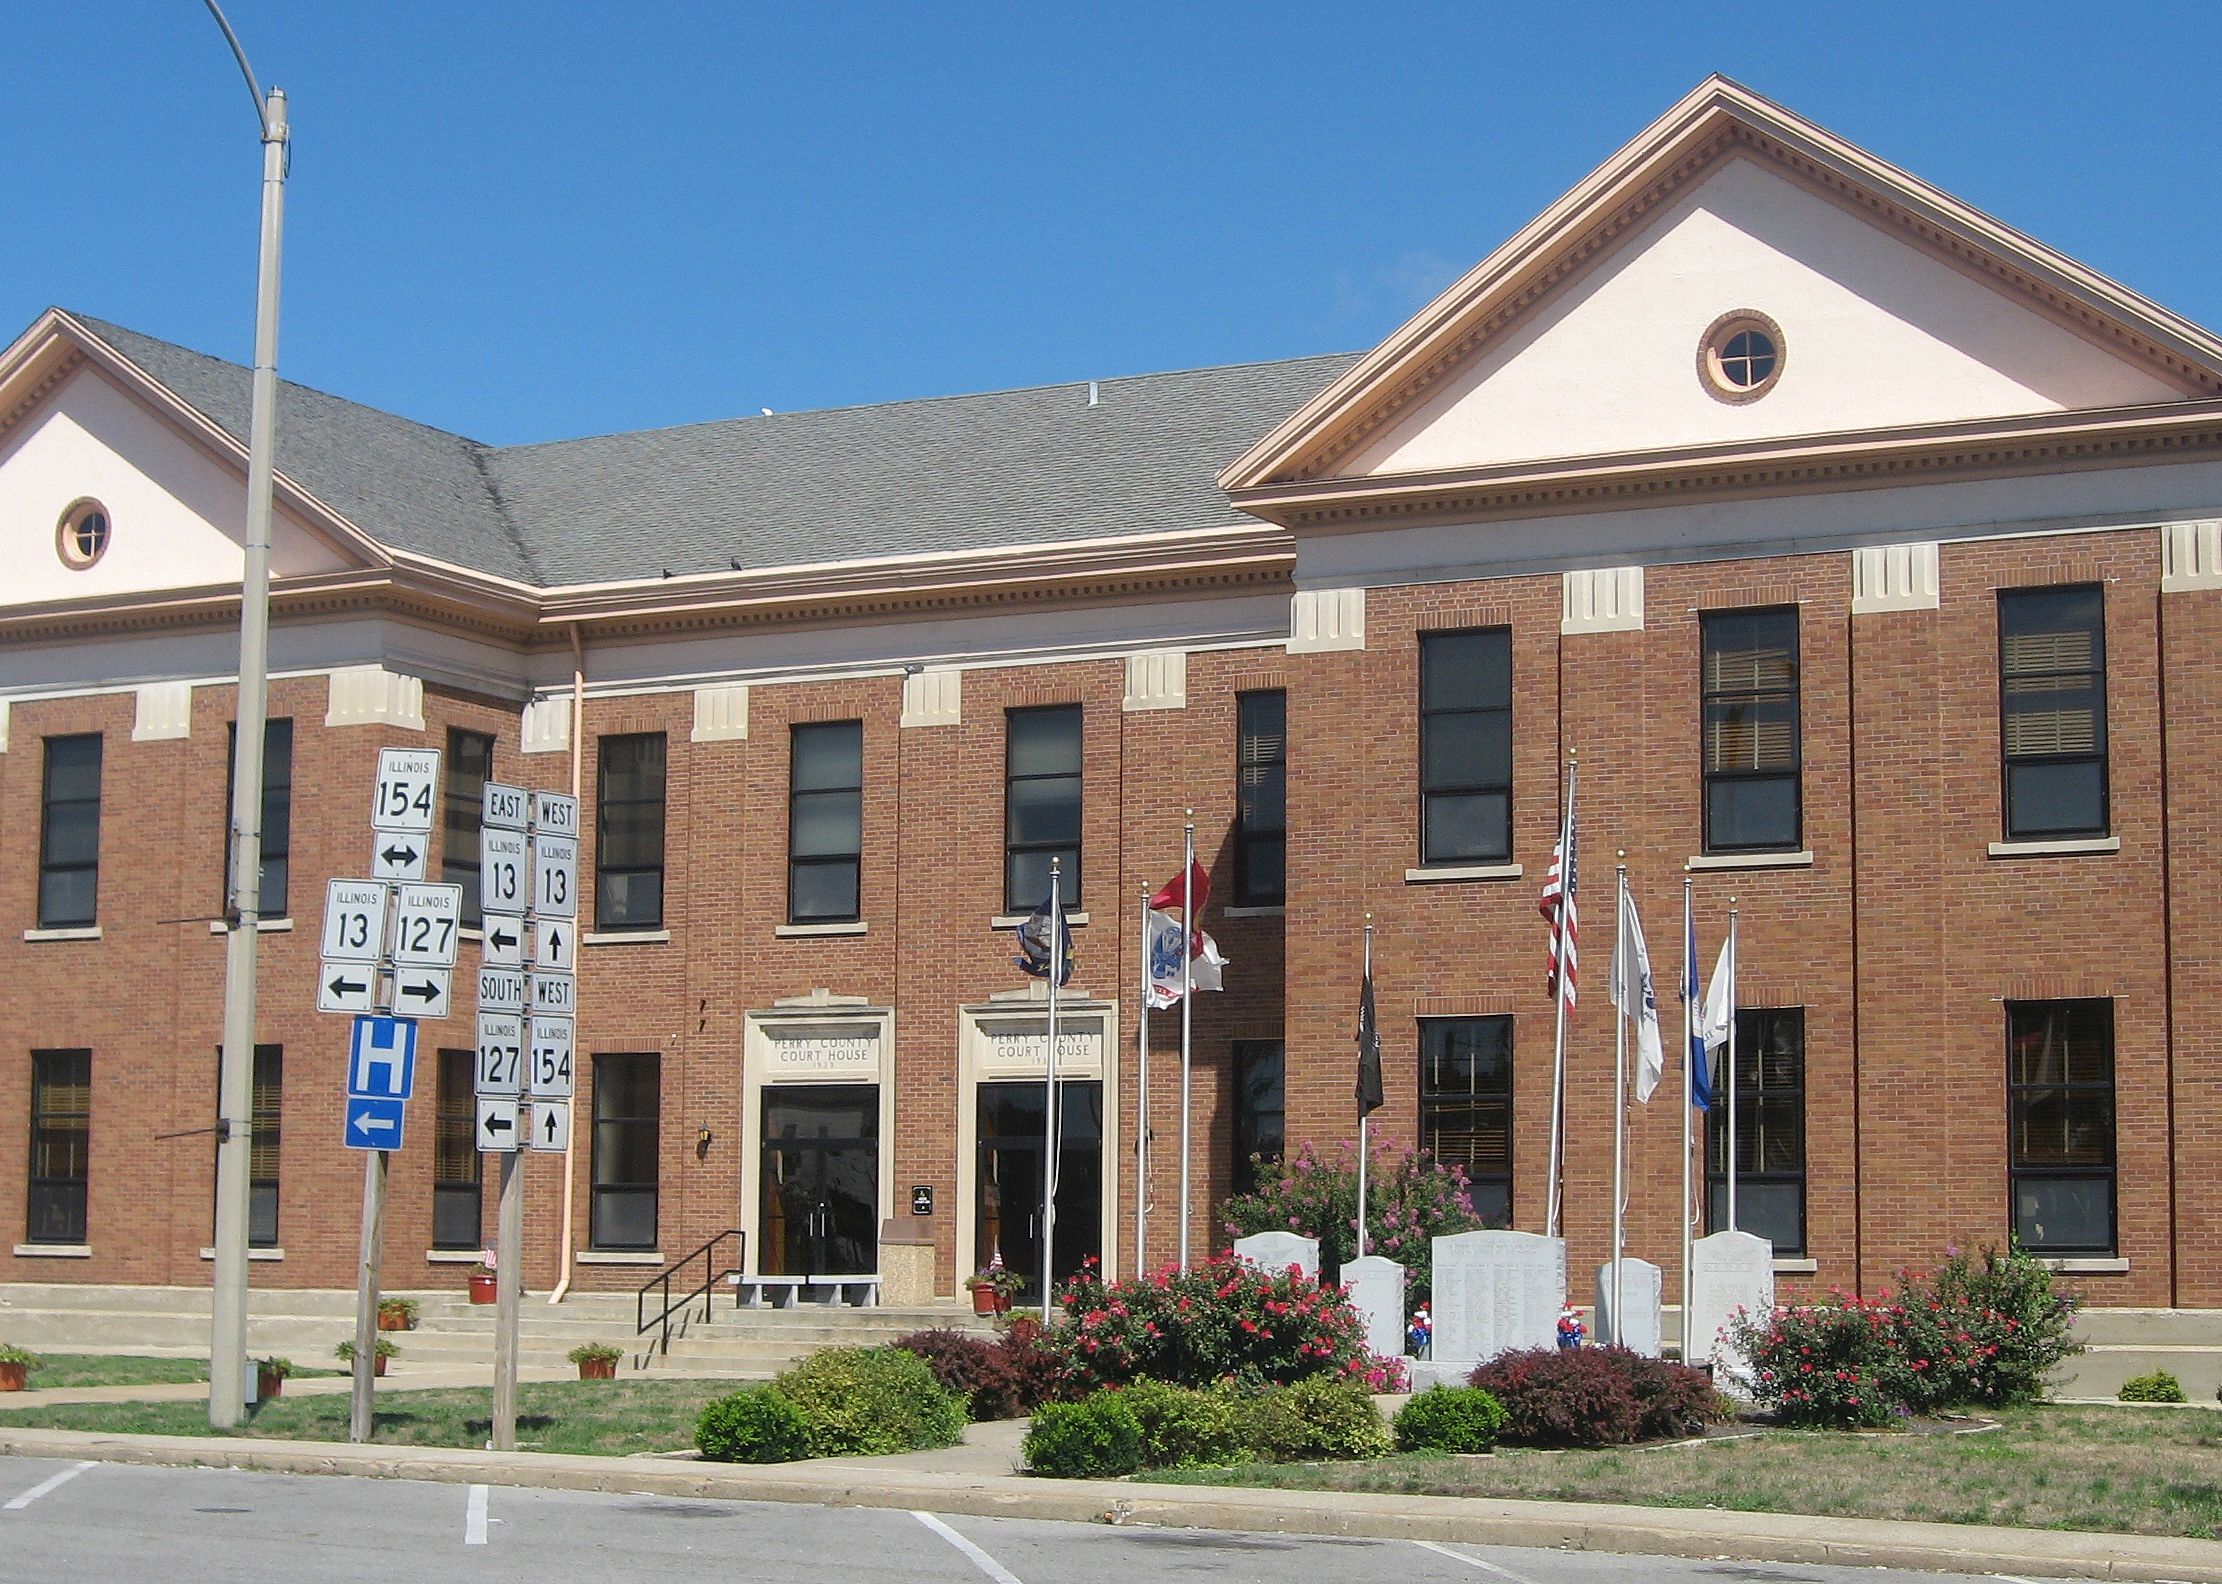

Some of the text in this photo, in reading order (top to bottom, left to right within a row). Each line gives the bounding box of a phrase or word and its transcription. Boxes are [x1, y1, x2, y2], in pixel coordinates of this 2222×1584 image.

[388, 762, 430, 773] ILLINOIS
[378, 781, 432, 818] 154
[490, 793, 521, 819] EAST
[541, 801, 573, 830] WEST
[488, 839, 521, 855] ILLINOIS
[541, 846, 572, 860] ILLINOIS
[493, 861, 516, 899] 13
[544, 867, 567, 904] 13
[336, 891, 377, 905] ILLINOIS
[407, 894, 450, 908] ILLINOIS
[338, 912, 369, 948] 13
[399, 915, 454, 953] 127
[481, 976, 523, 1001] SOUTH
[537, 980, 569, 1004] WEST
[484, 1022, 516, 1037] ILLINOIS
[536, 1026, 568, 1041] ILLINOIS
[990, 1032, 1094, 1044] PERRY CUNTY
[774, 1037, 873, 1049] PERRY COUNTY
[780, 1049, 868, 1061] COURT HOUSE
[997, 1044, 1089, 1057] COURT OUSE
[356, 1021, 407, 1093] H
[480, 1045, 520, 1083] 127
[531, 1048, 571, 1086] 154
